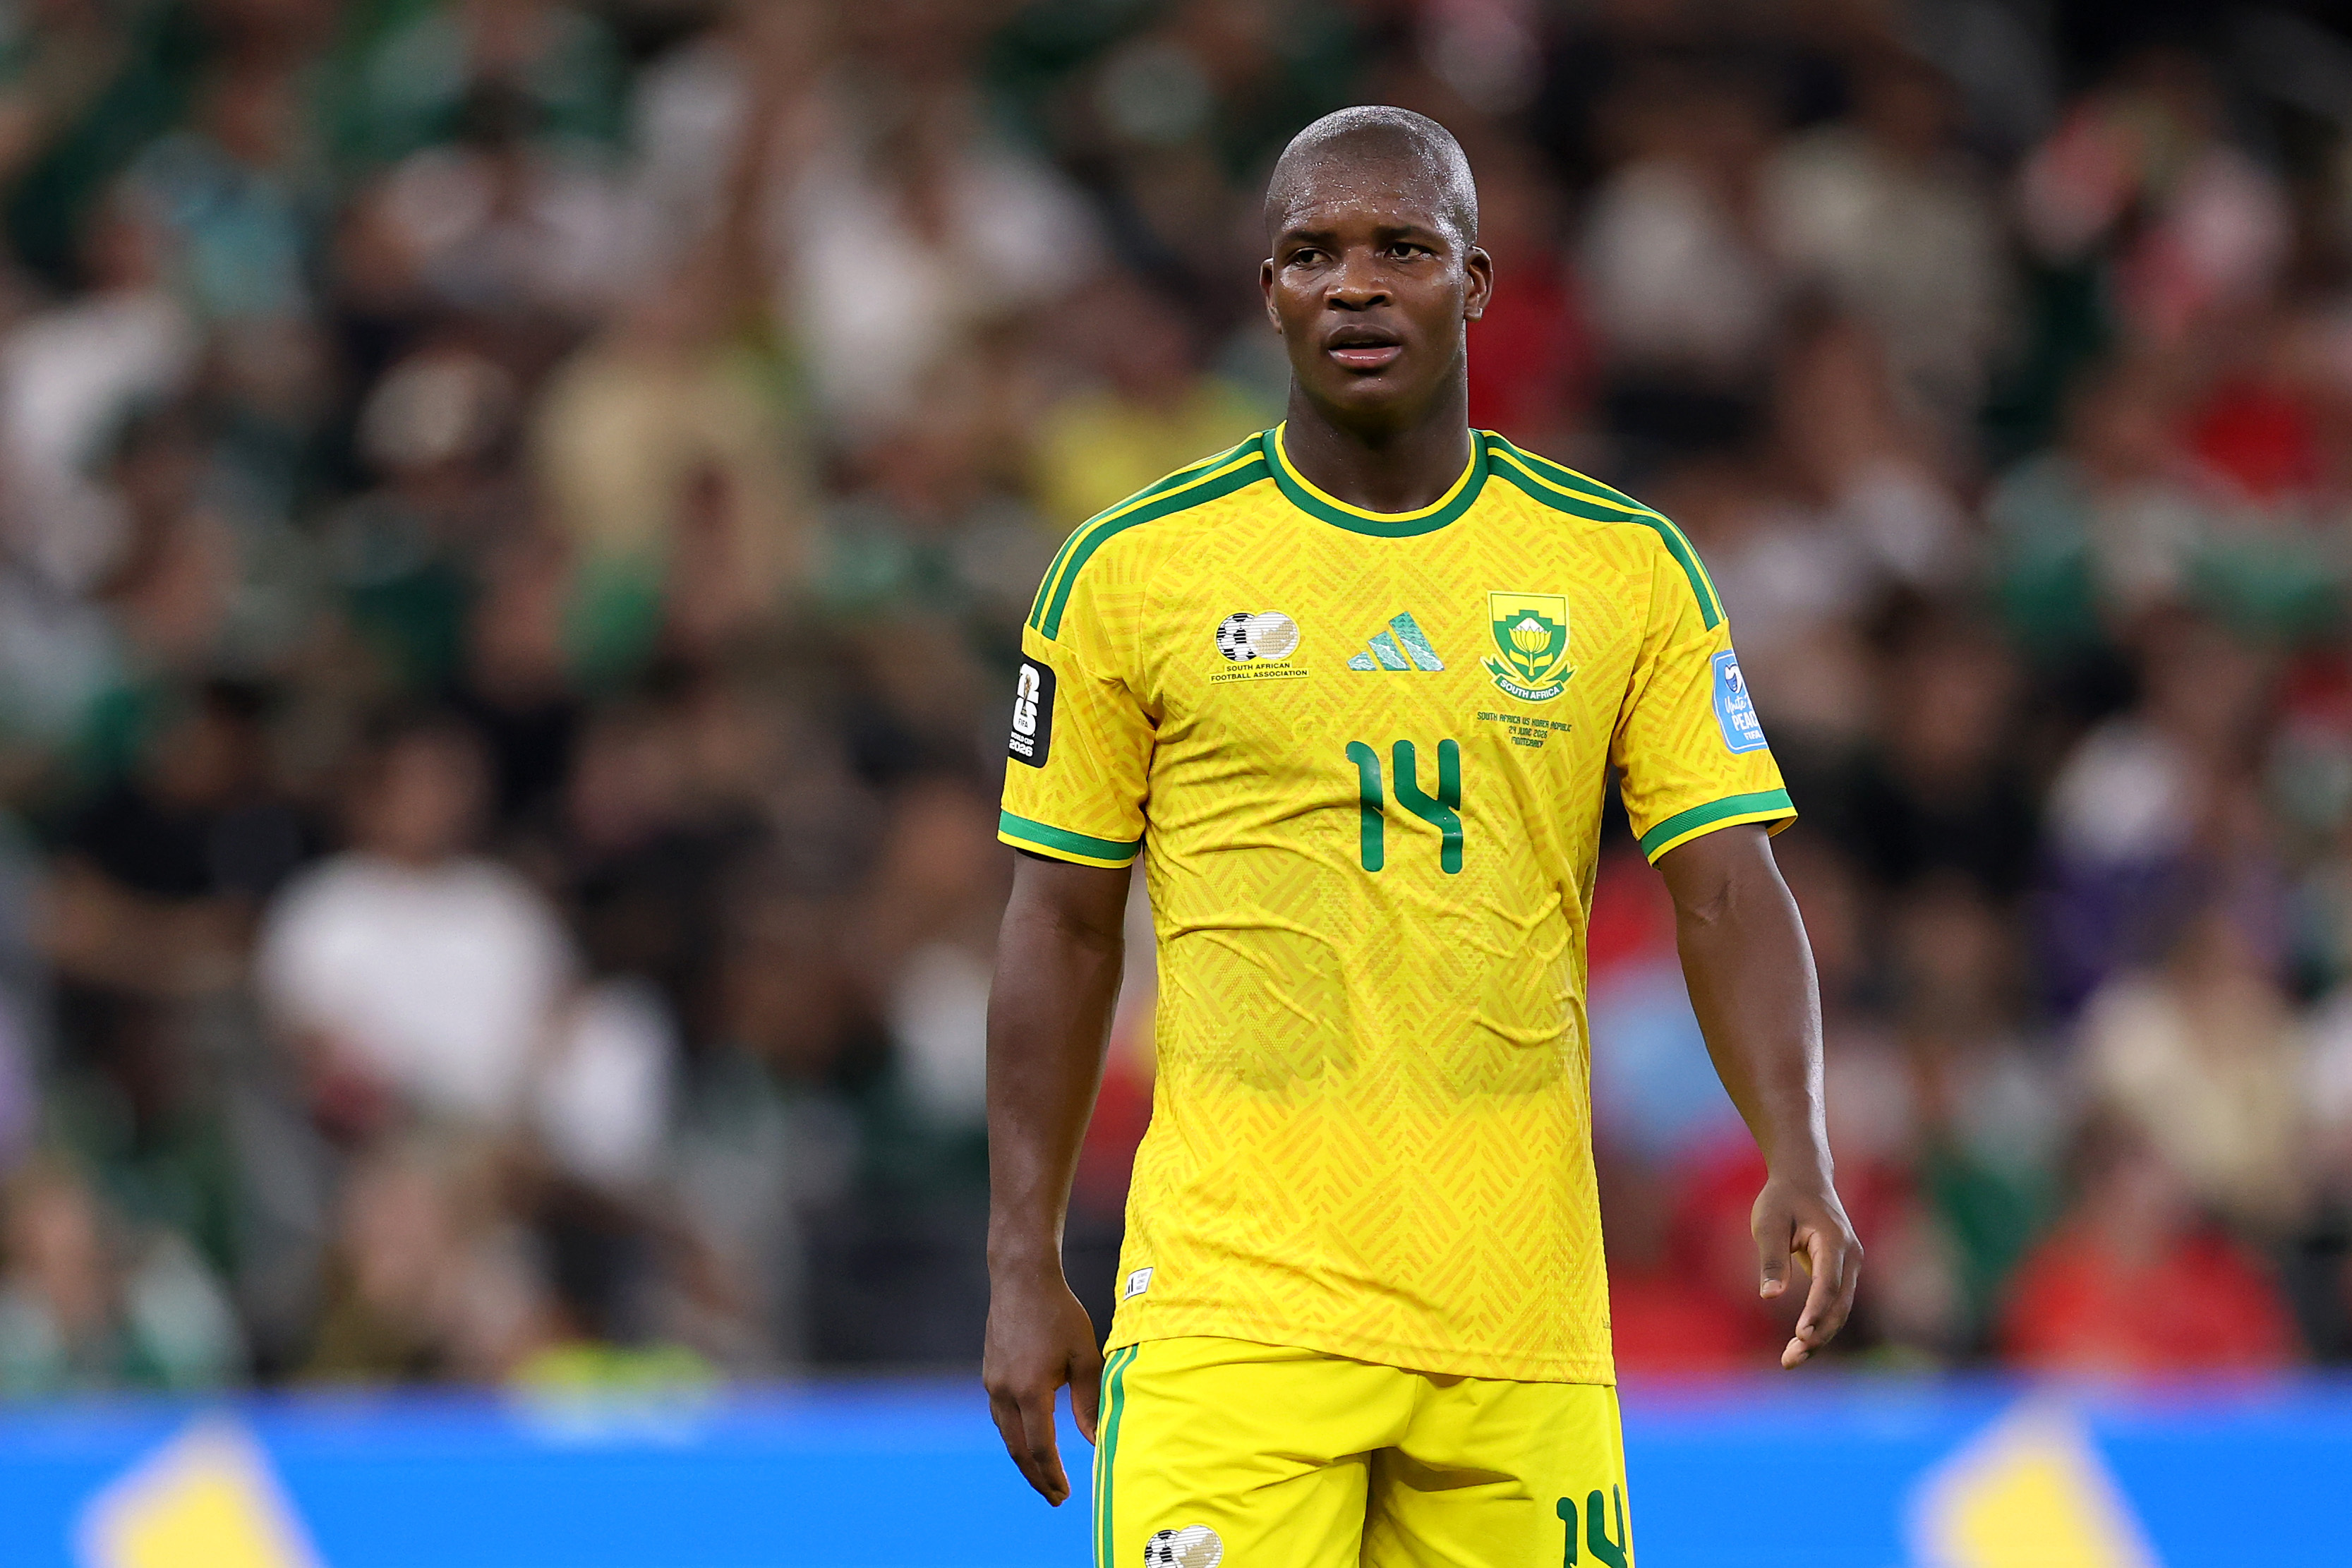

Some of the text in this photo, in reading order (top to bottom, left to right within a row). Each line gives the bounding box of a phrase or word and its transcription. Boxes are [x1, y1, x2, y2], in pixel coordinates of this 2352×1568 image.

[1211, 673, 1250, 681] FOOTBALL
[1500, 679, 1560, 699] SOUTH AFRICA
[1724, 695, 1747, 715] Unite
[1018, 718, 1028, 728] FIFA
[1477, 711, 1497, 721] SOUTH
[1499, 713, 1520, 724] AFRICA
[1531, 718, 1549, 728] KOREA
[1731, 710, 1759, 732] PEAC
[1024, 737, 1035, 746] CUP
[1517, 727, 1532, 737] JUNE
[1533, 729, 1548, 739] 2026
[1743, 730, 1762, 740] FIFA
[1008, 739, 1033, 757] 2026
[1345, 739, 1464, 875] 14
[1556, 1483, 1628, 1568] 14
